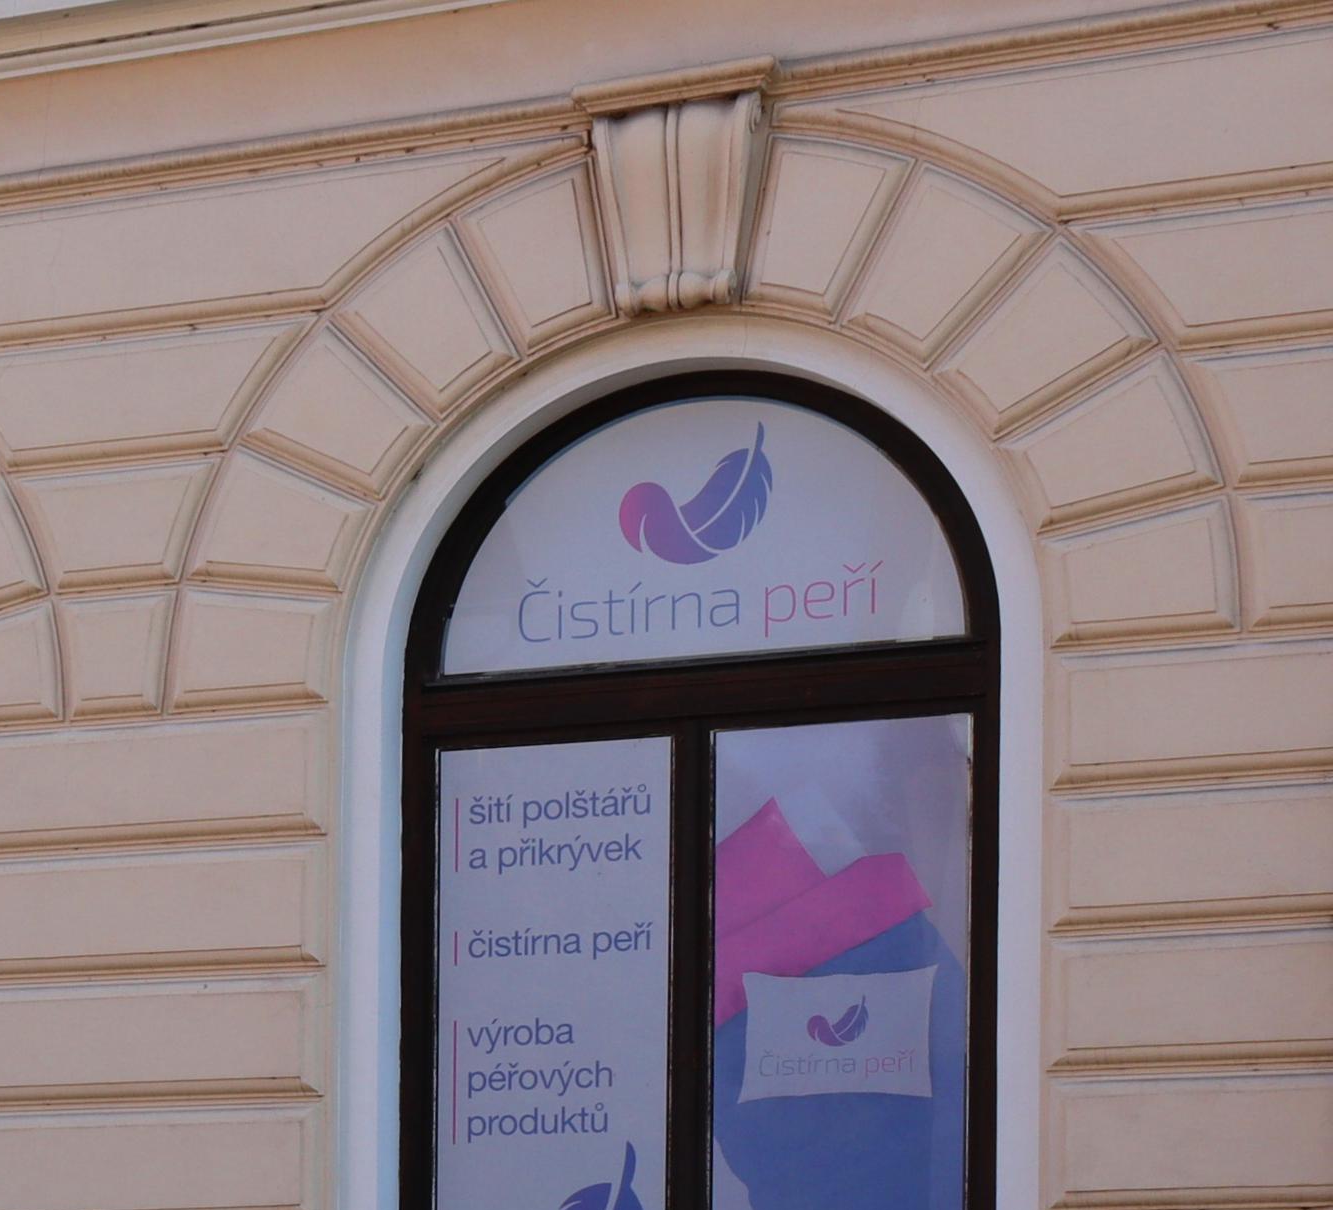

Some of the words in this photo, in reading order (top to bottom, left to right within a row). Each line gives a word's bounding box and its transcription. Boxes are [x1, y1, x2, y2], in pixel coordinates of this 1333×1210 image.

[517, 577, 740, 643] Čistírna
[764, 560, 884, 638] peří
[468, 795, 514, 825] šití
[523, 784, 652, 829] polštářů
[468, 848, 487, 870] a
[498, 834, 643, 875] přikrývek
[467, 927, 582, 959] čistírna
[591, 922, 653, 960] peří
[466, 1018, 575, 1054] výroba
[467, 1060, 614, 1099] péřových
[758, 1051, 856, 1077] Čistírna
[865, 1048, 916, 1078] peří
[466, 1102, 609, 1144] produktů
